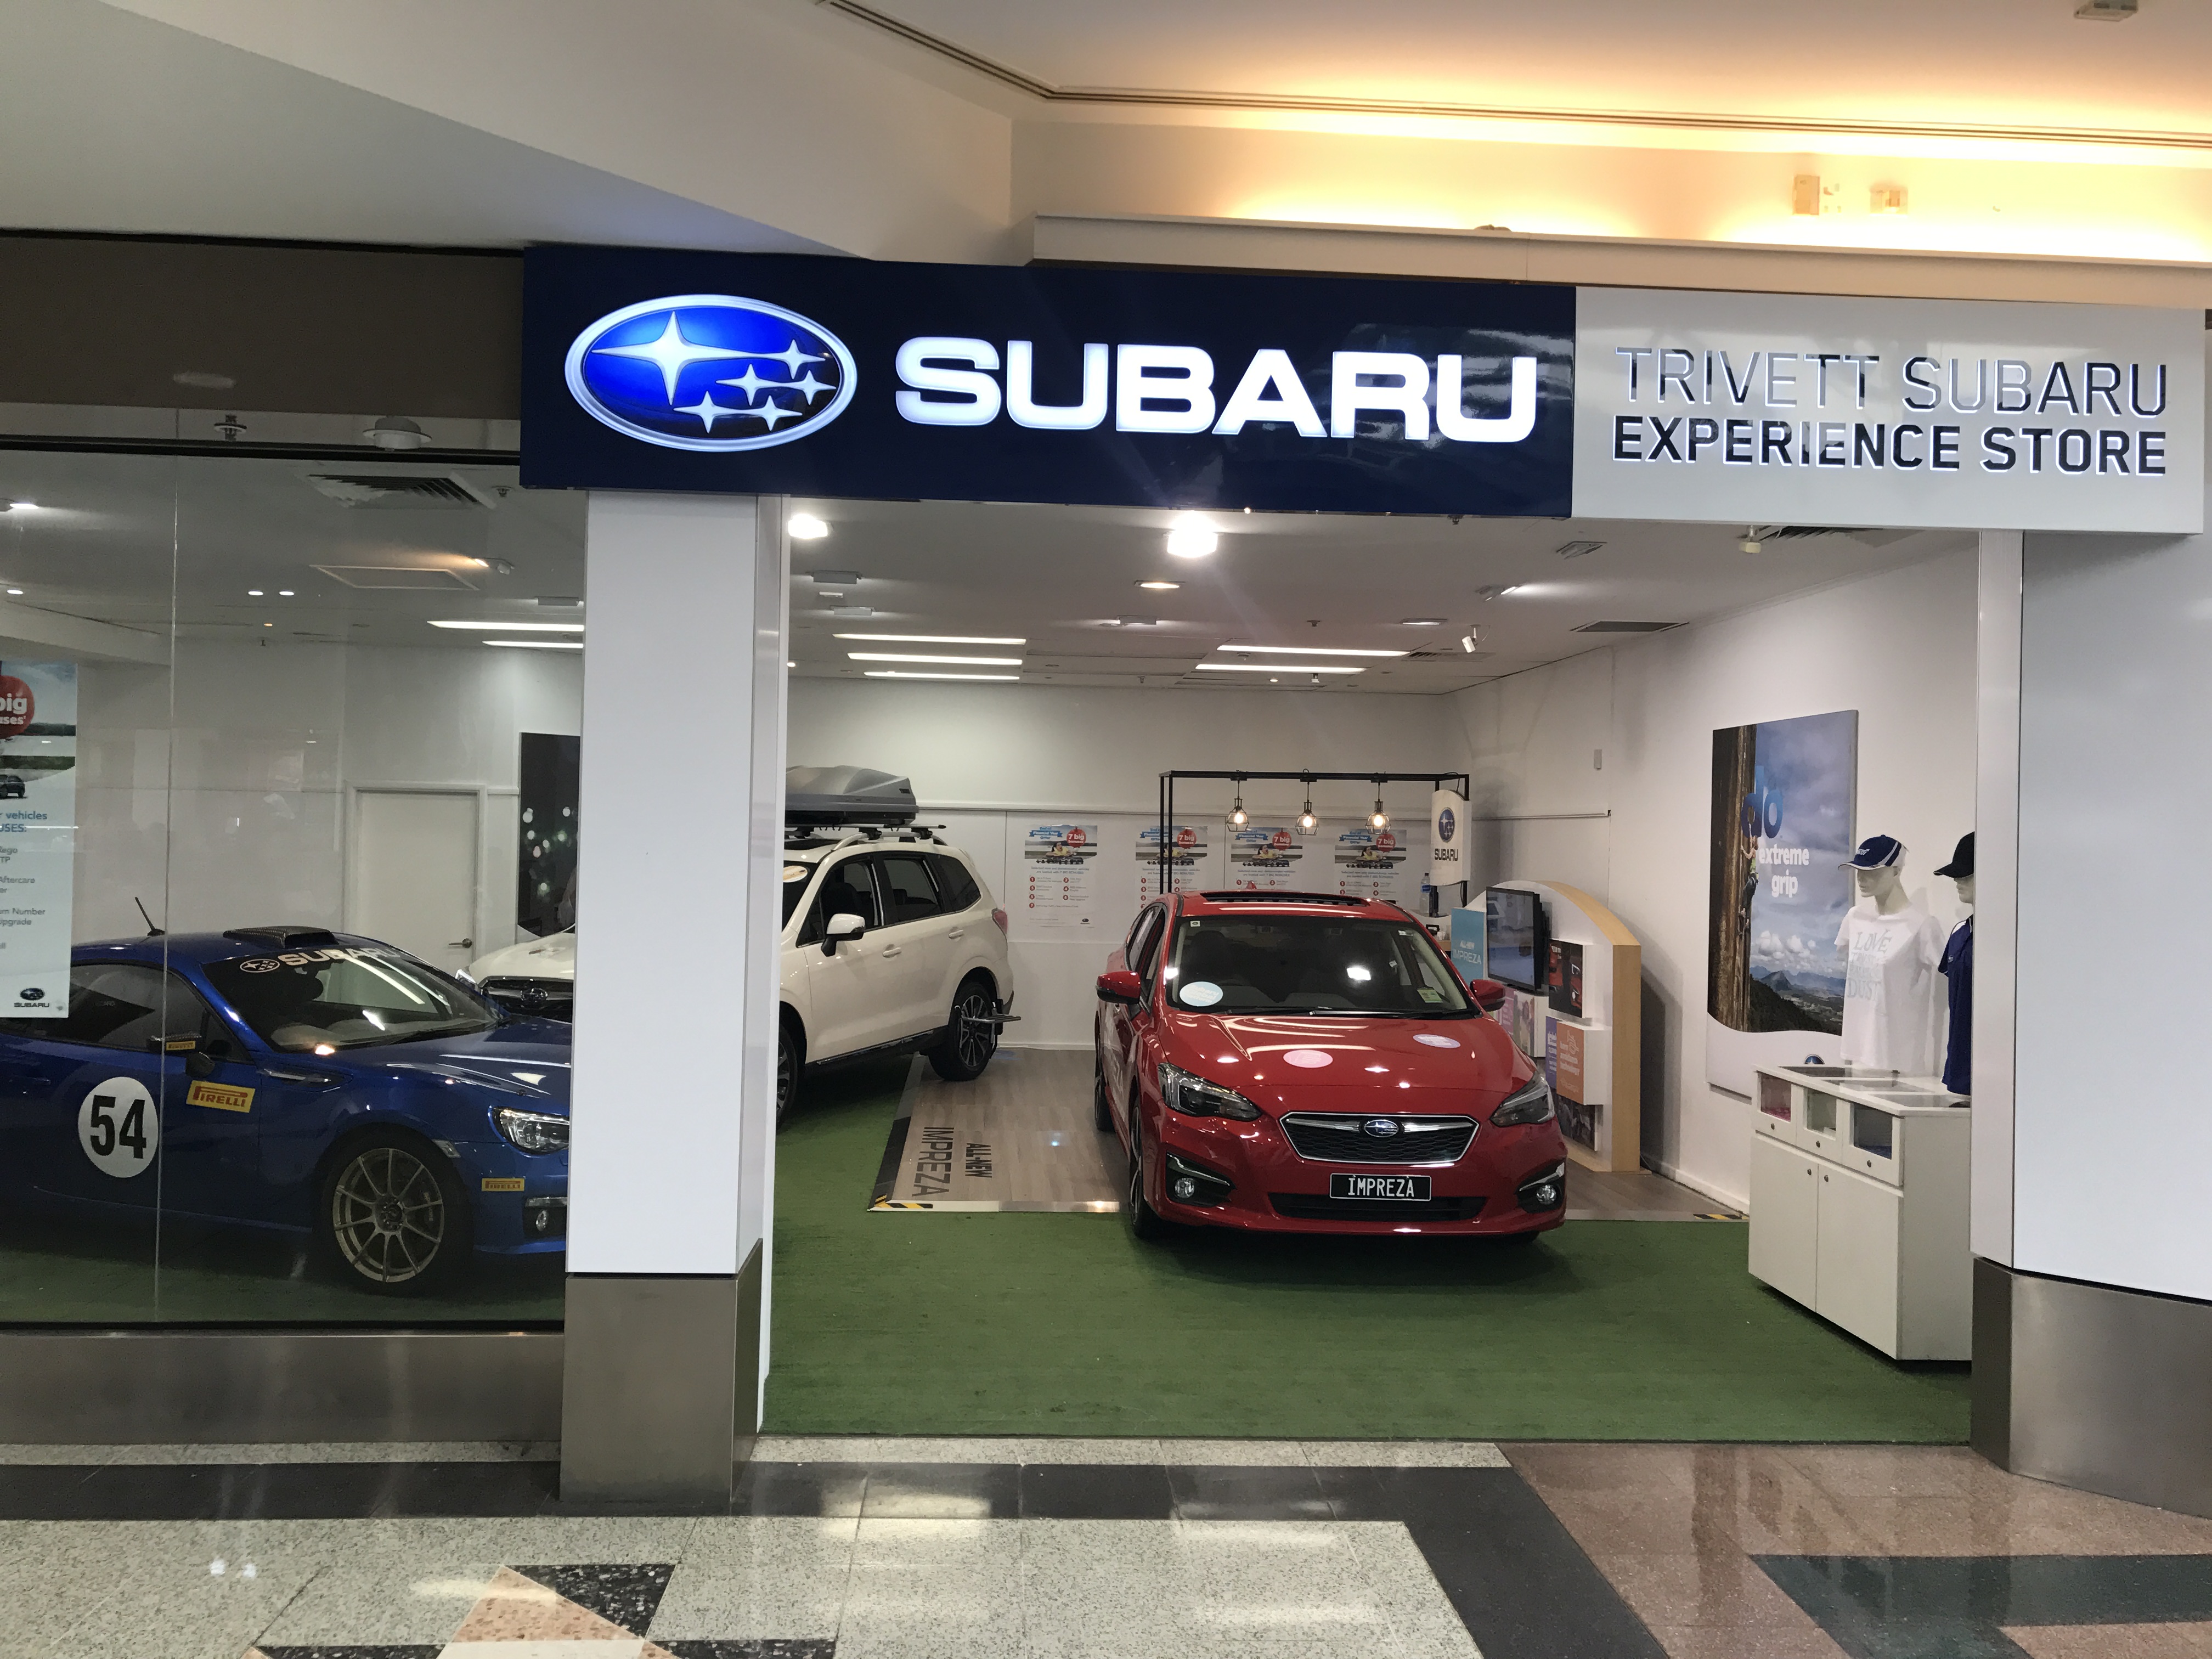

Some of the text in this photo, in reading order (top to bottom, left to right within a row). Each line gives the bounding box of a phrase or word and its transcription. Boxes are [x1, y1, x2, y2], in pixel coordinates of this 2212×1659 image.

[896, 336, 1537, 443] SUBARU
[1615, 347, 2168, 418] TRIVETT SUBARU
[1612, 415, 2168, 477] EXPERIENCE STORE
[1741, 765, 1784, 839] do
[5, 810, 48, 820] vehicles
[1434, 848, 1459, 861] SUBARU
[1758, 843, 1810, 866] extreme
[1771, 868, 1798, 898] grip
[1853, 928, 1893, 954] LOVE
[277, 947, 401, 966] SUBARU
[1453, 949, 1482, 964] IMPREZA
[1847, 977, 1882, 1001] DUST
[193, 1085, 249, 1108] PIRELLI
[90, 1094, 147, 1159] 54
[911, 1126, 955, 1198] IMPREZA
[485, 1181, 521, 1189] PIRELLI
[1347, 1177, 1415, 1198] IMPREZA
